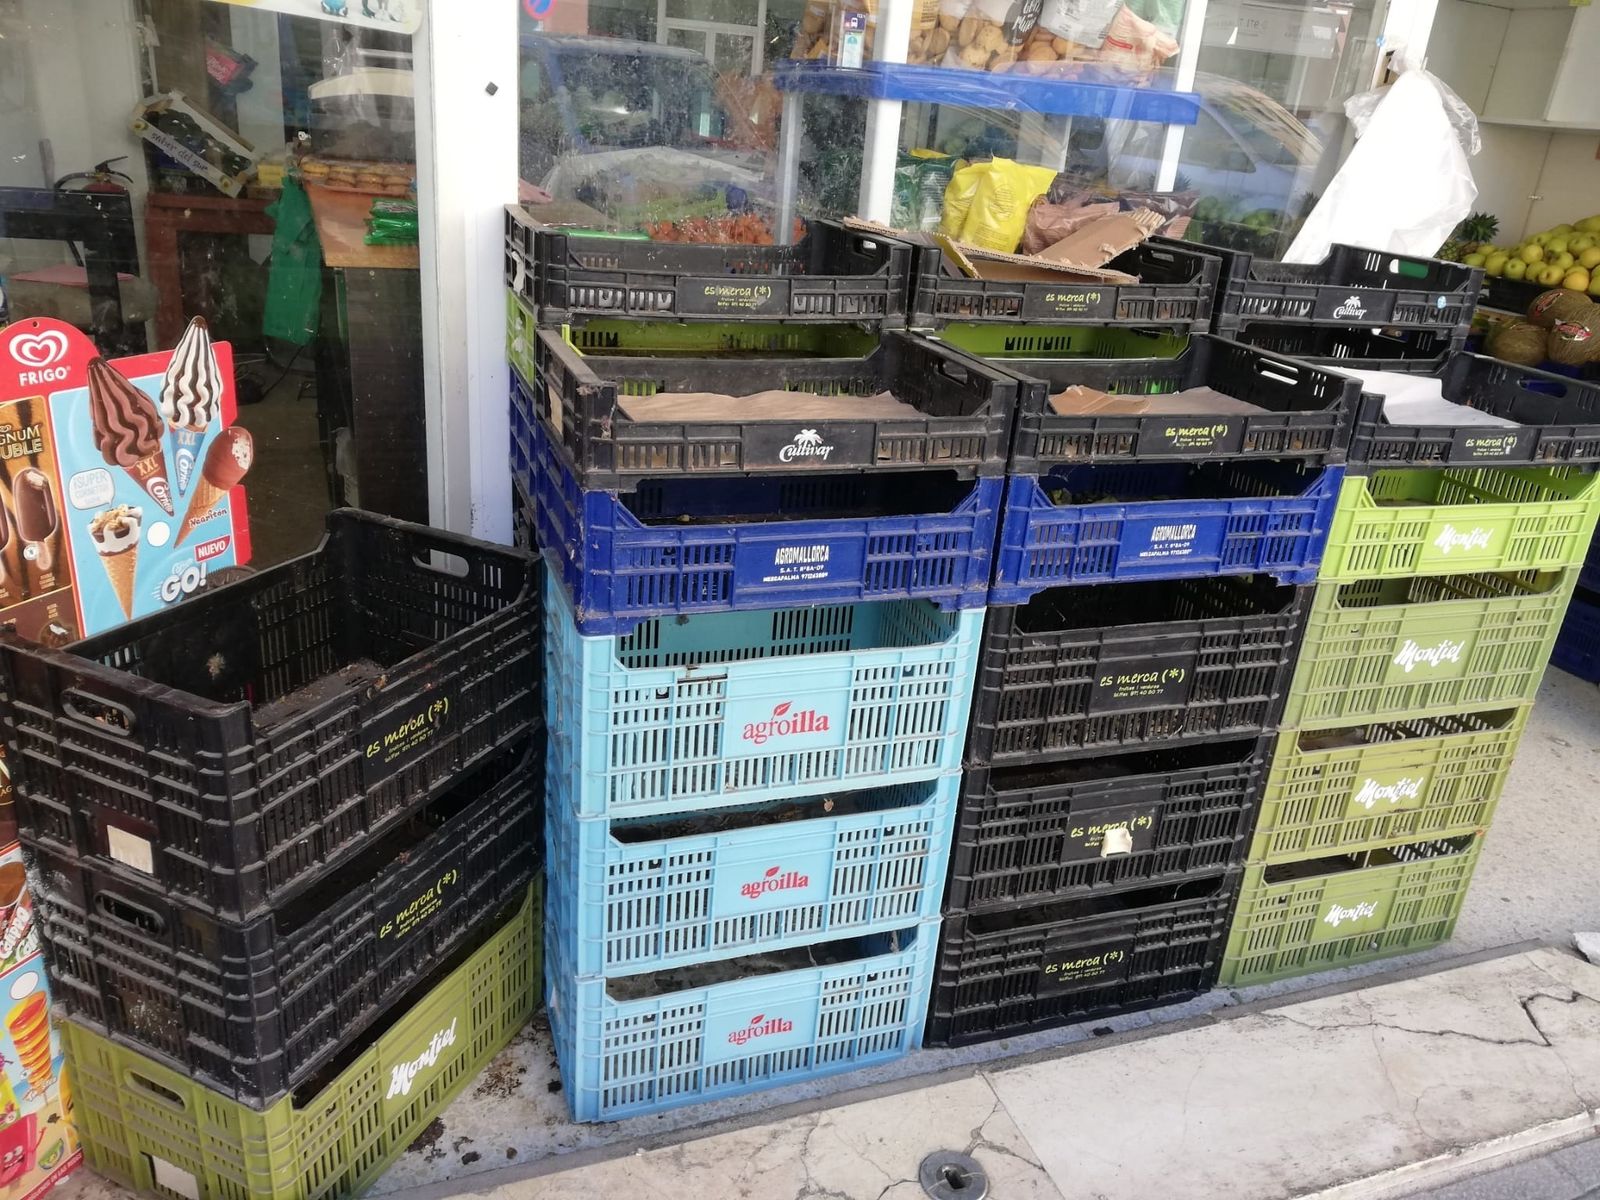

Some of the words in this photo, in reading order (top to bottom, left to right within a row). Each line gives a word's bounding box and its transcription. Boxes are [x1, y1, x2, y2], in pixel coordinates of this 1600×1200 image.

[704, 286, 715, 295] es
[719, 287, 752, 297] merca
[1045, 293, 1055, 302] es
[1057, 294, 1085, 302] merca
[1333, 303, 1367, 320] Cultivar
[19, 366, 67, 387] FRIGO
[177, 431, 197, 446] XXL
[1165, 427, 1176, 437] es
[1178, 427, 1210, 436] merca
[1466, 438, 1475, 447] es
[1476, 438, 1502, 447] merca
[779, 441, 834, 463] Cultivar
[136, 452, 160, 478] XXL
[1151, 524, 1197, 542] AGROMALLORCA
[1434, 523, 1495, 555] Montiel
[198, 540, 226, 559] NUEVO
[775, 545, 830, 566] AGROMALLORCA
[161, 562, 207, 602] GO!
[1393, 639, 1466, 673] Montiel
[1100, 676, 1113, 687] es
[1117, 671, 1159, 685] merca
[367, 741, 381, 758] es
[384, 713, 425, 747] merca
[743, 707, 830, 745] agroilla
[1354, 777, 1424, 810] Montiel
[1071, 827, 1084, 838] es
[741, 871, 809, 899] agroilla
[380, 921, 393, 939] es
[396, 887, 434, 925] merca
[1323, 901, 1378, 928] Montiel
[1045, 963, 1058, 974] es
[1062, 956, 1101, 970] merca
[728, 1017, 793, 1046] agroilla
[386, 1016, 457, 1100] Montiel
